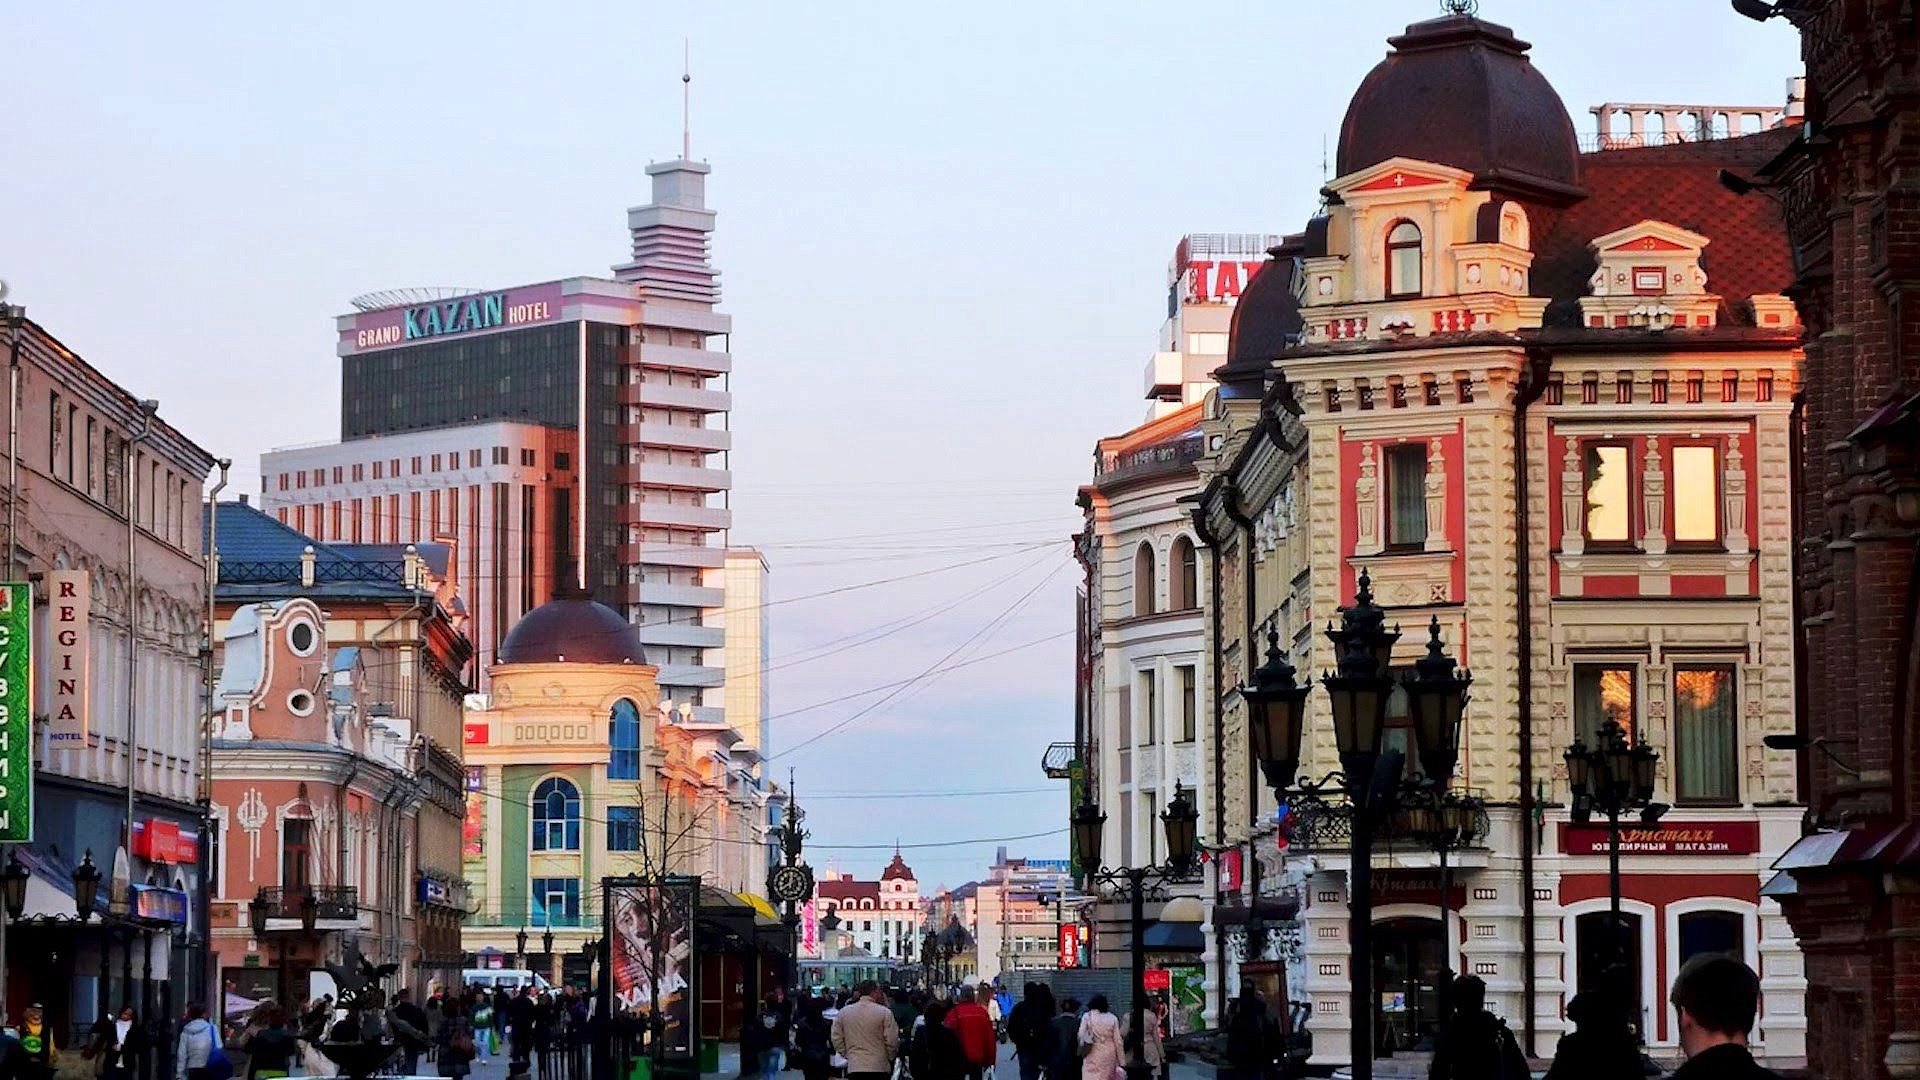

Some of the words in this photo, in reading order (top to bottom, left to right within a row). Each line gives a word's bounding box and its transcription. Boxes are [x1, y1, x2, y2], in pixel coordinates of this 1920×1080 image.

[358, 326, 401, 347] GRAND
[404, 294, 503, 339] KAZAN
[509, 302, 551, 324] HOTEL
[58, 581, 77, 720] REGINA
[50, 731, 84, 741] HOTEL
[1591, 842, 1667, 851] ЮВЛИРНЫЙ
[1674, 842, 1729, 851] МАГАЗИН
